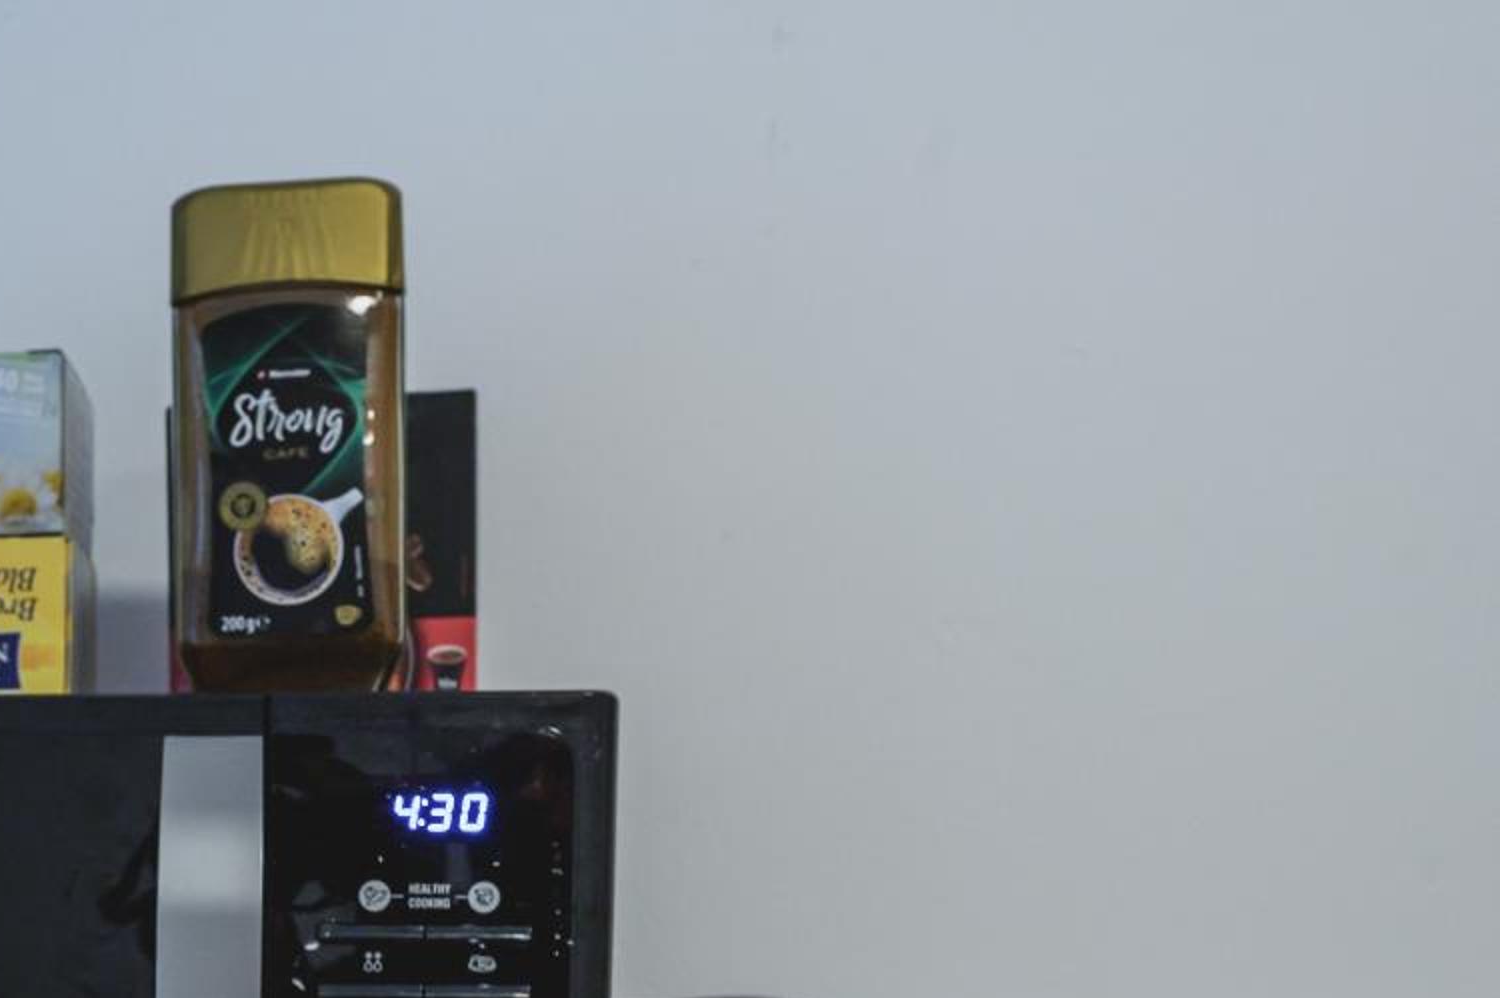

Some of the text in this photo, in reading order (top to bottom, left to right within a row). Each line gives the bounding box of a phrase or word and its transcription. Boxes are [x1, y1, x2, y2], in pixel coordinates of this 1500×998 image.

[229, 388, 344, 454] Strong
[393, 792, 489, 833] 4:30
[408, 883, 451, 895] HEALTHY
[407, 897, 451, 909] COOKING
